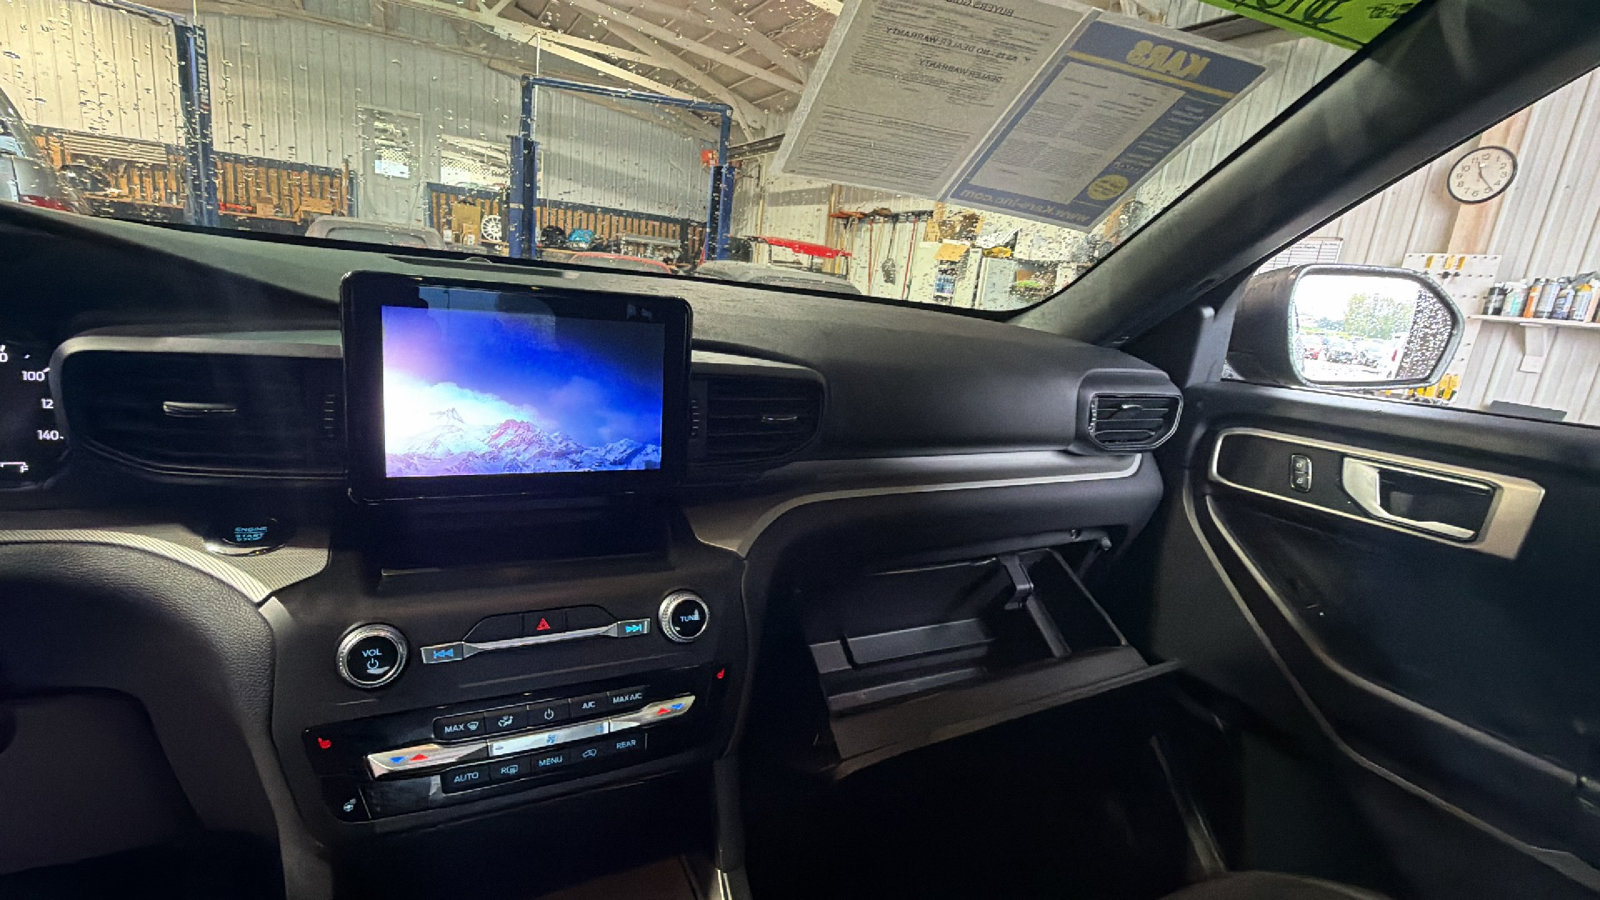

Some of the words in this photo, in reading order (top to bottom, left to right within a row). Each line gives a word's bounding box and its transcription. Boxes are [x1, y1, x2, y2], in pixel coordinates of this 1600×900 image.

[22, 370, 46, 381] 100
[37, 429, 59, 441] 140
[19, 464, 29, 474] F
[362, 648, 383, 658] VOL
[613, 695, 629, 704] MAX
[582, 701, 596, 709] A/C
[444, 724, 465, 734] MAX
[616, 739, 637, 749] REAR
[538, 755, 563, 767] MENU
[453, 771, 479, 783] AUTO
